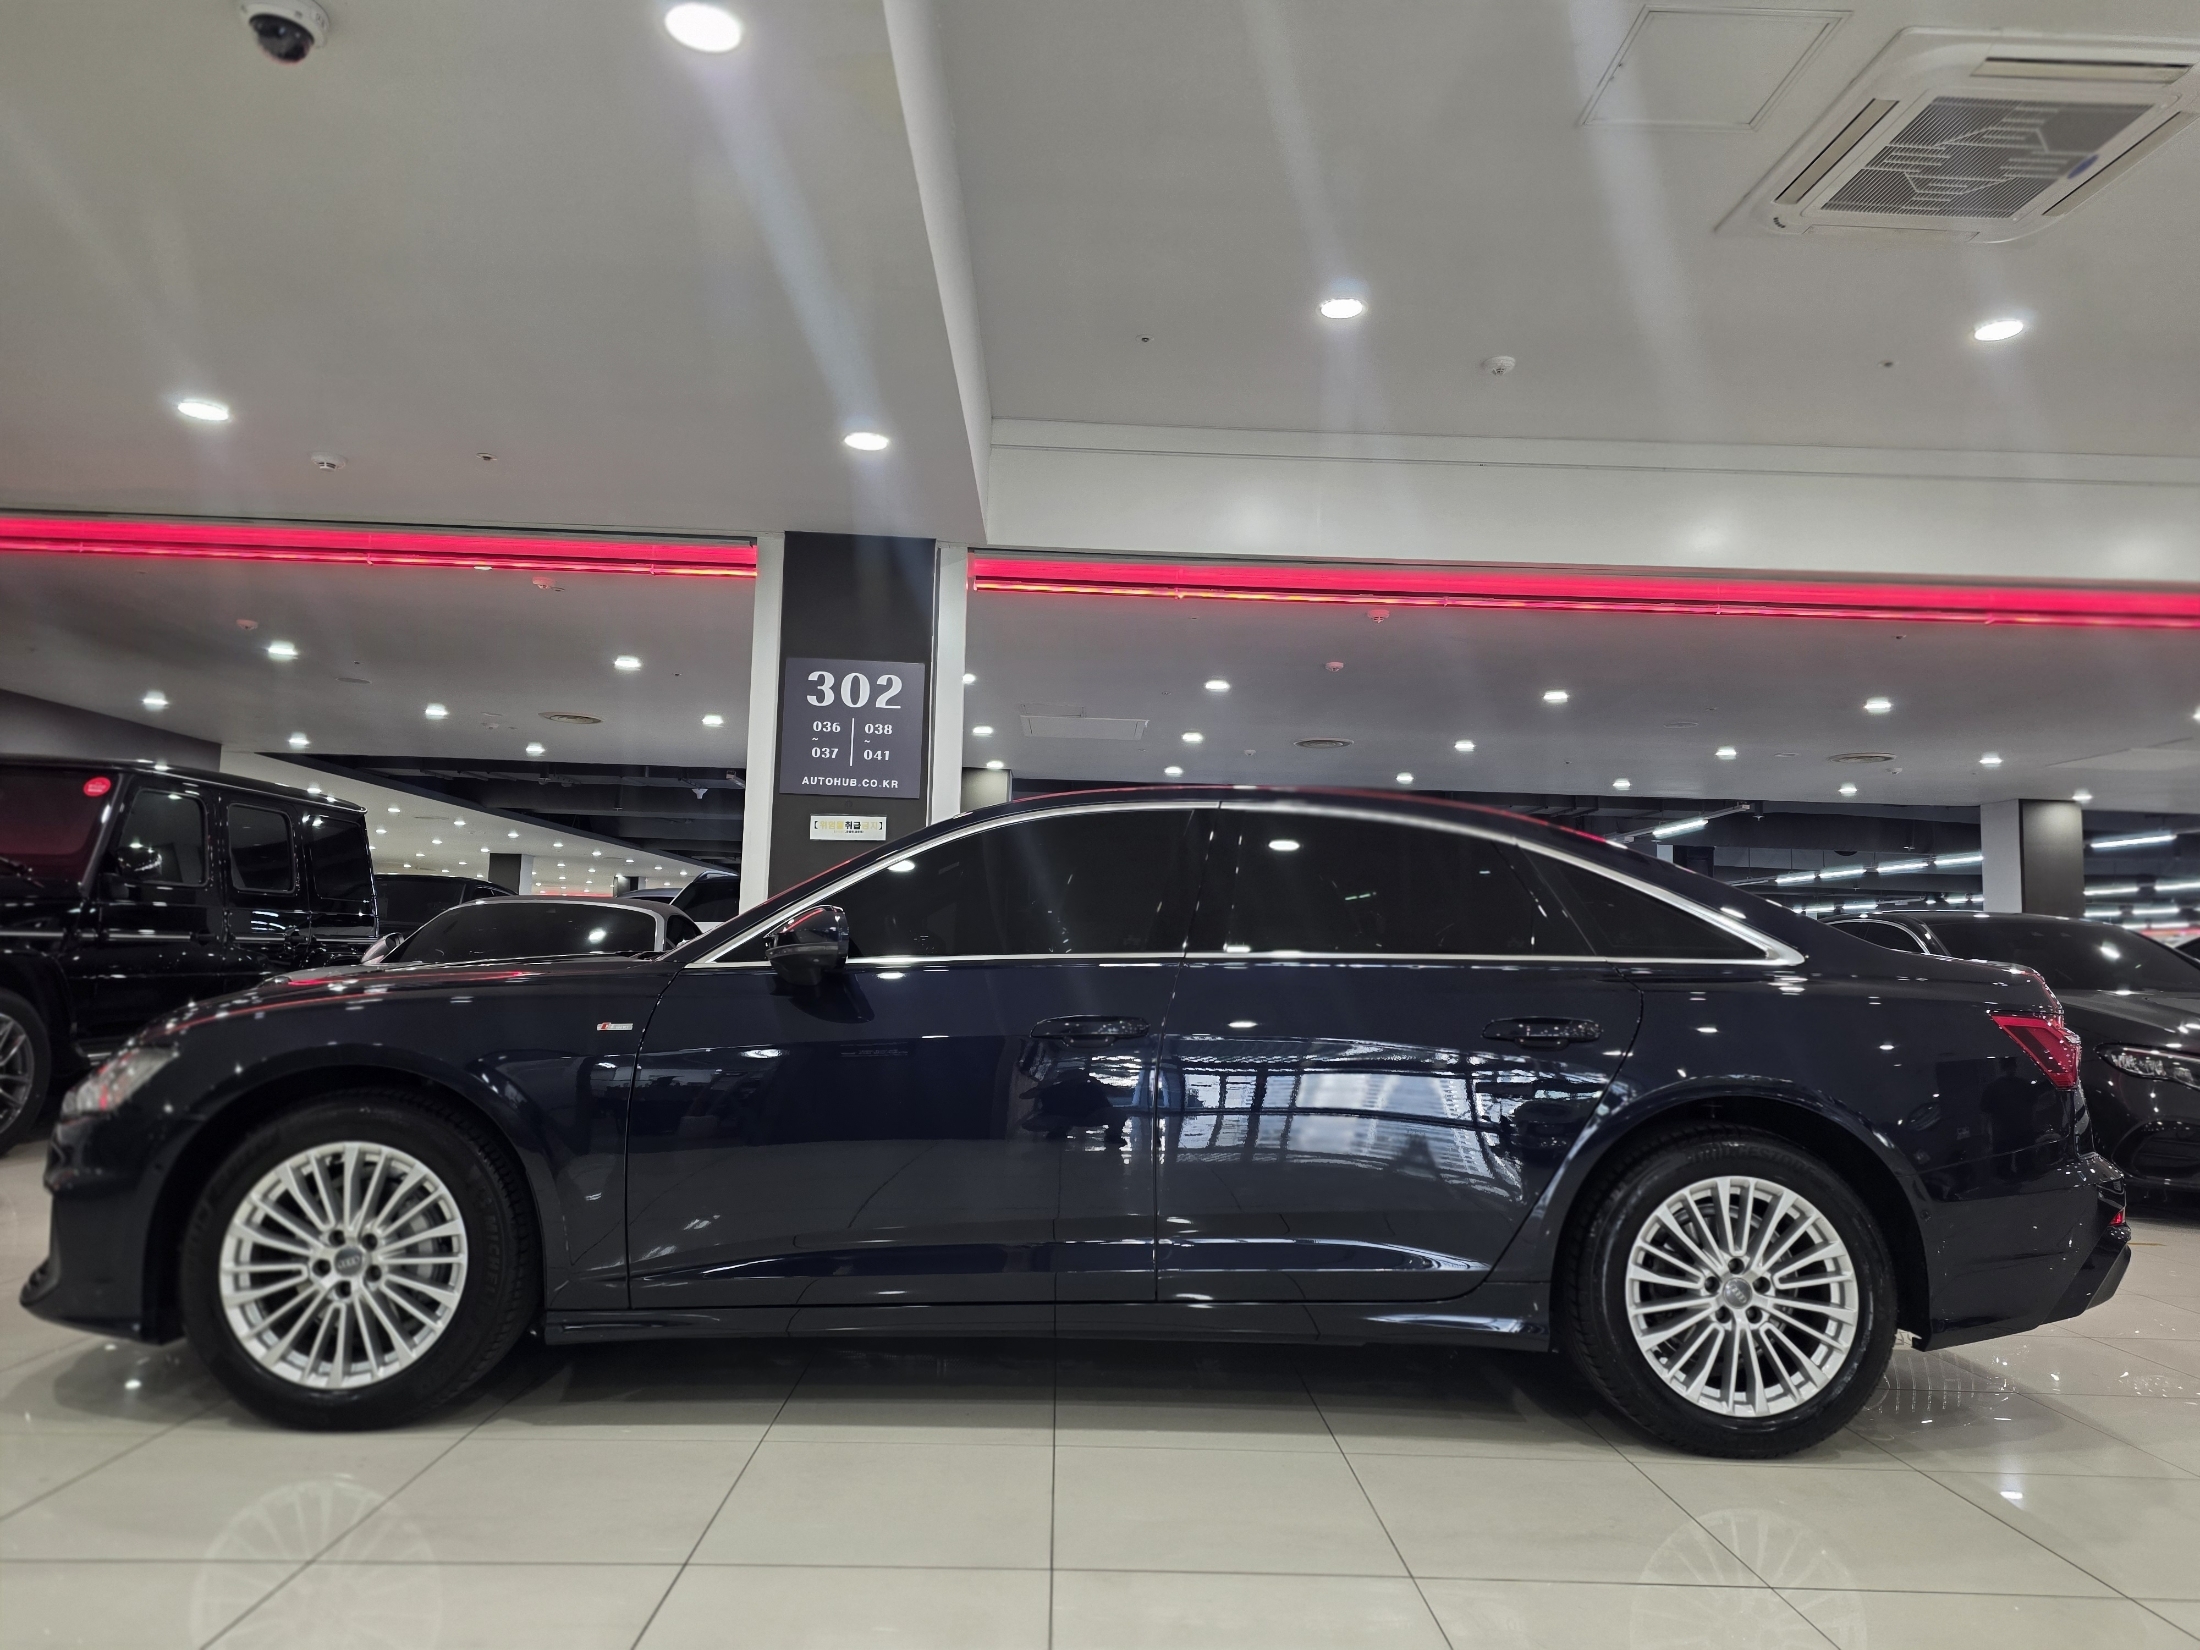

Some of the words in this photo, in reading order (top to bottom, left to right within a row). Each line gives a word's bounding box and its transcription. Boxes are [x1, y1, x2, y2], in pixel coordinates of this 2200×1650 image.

[806, 670, 903, 709] 302
[812, 720, 841, 733] 036
[864, 723, 893, 735] 038
[811, 747, 839, 759] 037
[863, 749, 890, 761] 041
[801, 776, 899, 789] AUTOHUB.CO.KR
